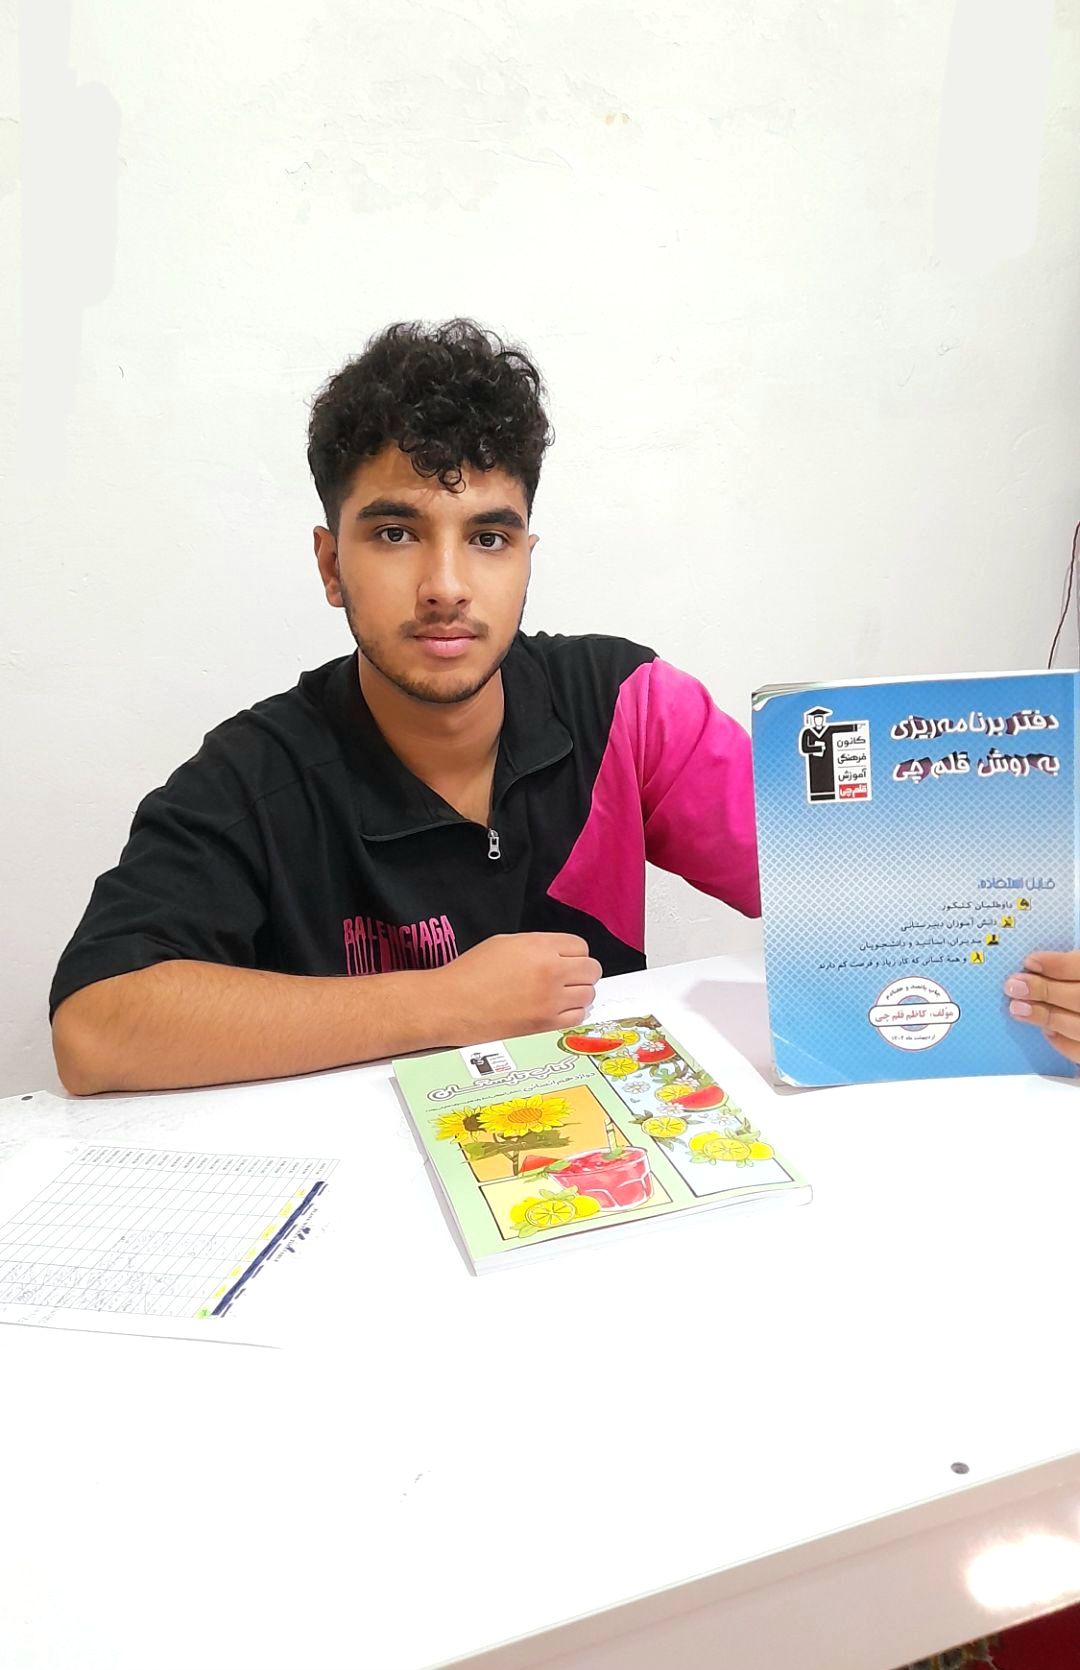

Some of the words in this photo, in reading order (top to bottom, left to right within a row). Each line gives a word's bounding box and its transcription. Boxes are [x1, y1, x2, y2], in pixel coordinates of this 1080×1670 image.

[1010, 709, 1060, 736] دفتر
[836, 735, 866, 748] کانون
[837, 752, 867, 765] فرهنگی
[977, 748, 1031, 777] روش
[930, 752, 971, 779] قلم
[1036, 755, 1061, 776] به
[838, 768, 867, 782] آموزش
[892, 760, 925, 784] چی
[1025, 877, 1056, 890] قابل
[942, 901, 973, 912] کنکور
[974, 901, 1013, 911] داوطلبان
[900, 920, 944, 932] دبیرستانی
[946, 917, 974, 929] آموزان
[976, 920, 998, 929] دانش
[343, 915, 459, 977] BALENCIAGA
[859, 940, 906, 952] دانشجویان
[915, 937, 945, 947] اساتید
[818, 960, 836, 970] دارند
[838, 960, 848, 970] کم
[849, 960, 873, 969] فرصت
[882, 958, 896, 967] زیاد
[922, 955, 945, 967] کسانی
[874, 1013, 890, 1023] چی
[891, 1010, 905, 1022] قلم
[905, 1009, 927, 1021] کاظم
[529, 1054, 580, 1079] کتاب
